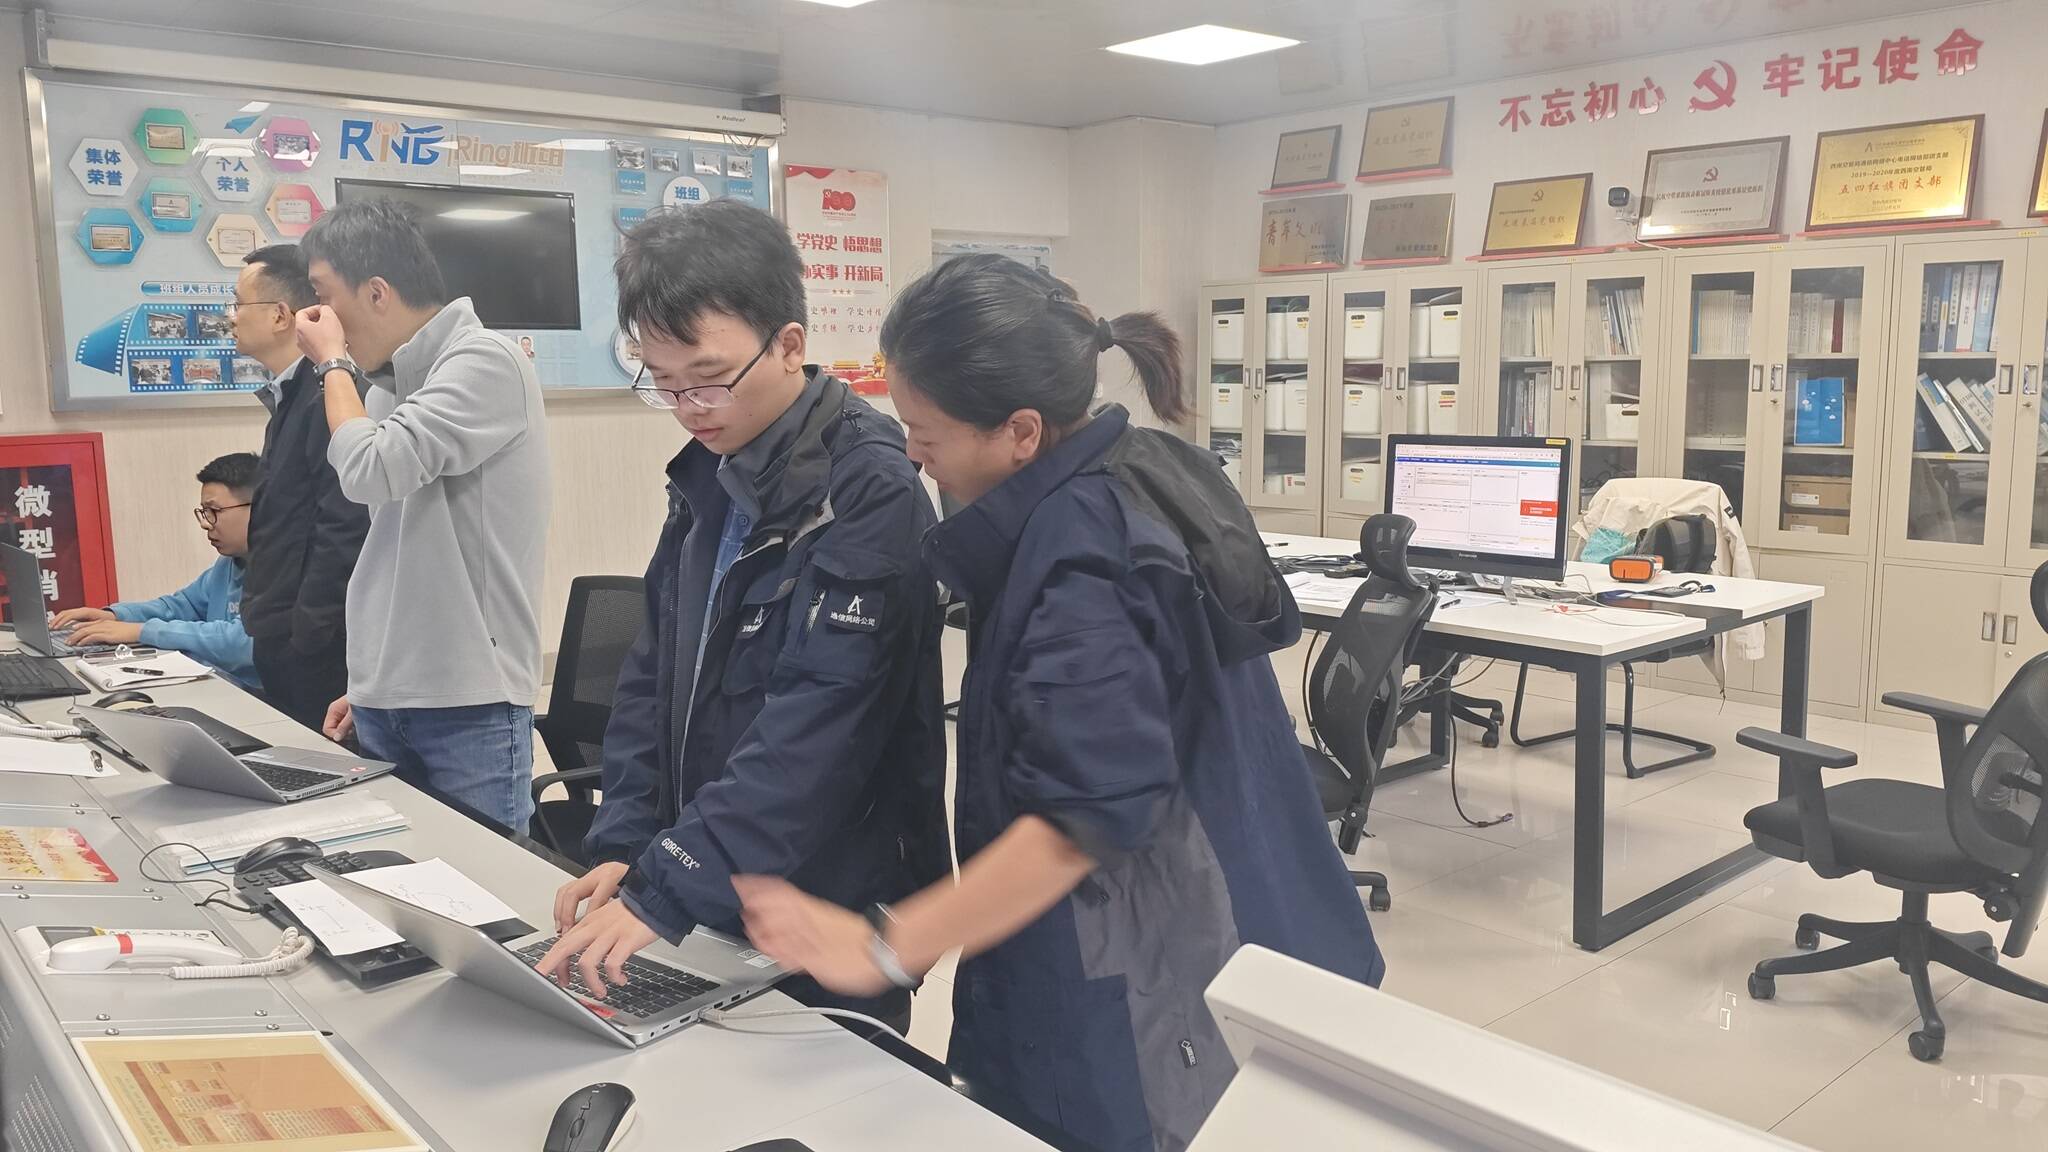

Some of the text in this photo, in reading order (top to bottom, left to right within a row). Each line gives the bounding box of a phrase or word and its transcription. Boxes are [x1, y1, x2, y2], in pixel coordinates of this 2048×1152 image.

[1498, 28, 1984, 132] 不忘初心 牢记使命
[339, 119, 445, 165] RING
[86, 147, 122, 166] 集体
[216, 157, 249, 172] 个人
[87, 169, 123, 187] 荣誉
[217, 176, 250, 193] 荣誉
[1839, 175, 1942, 195] 五四红旗团支部
[674, 186, 701, 201] 班组
[796, 232, 883, 254] 学党史 悟思想
[843, 264, 884, 282] 开新局
